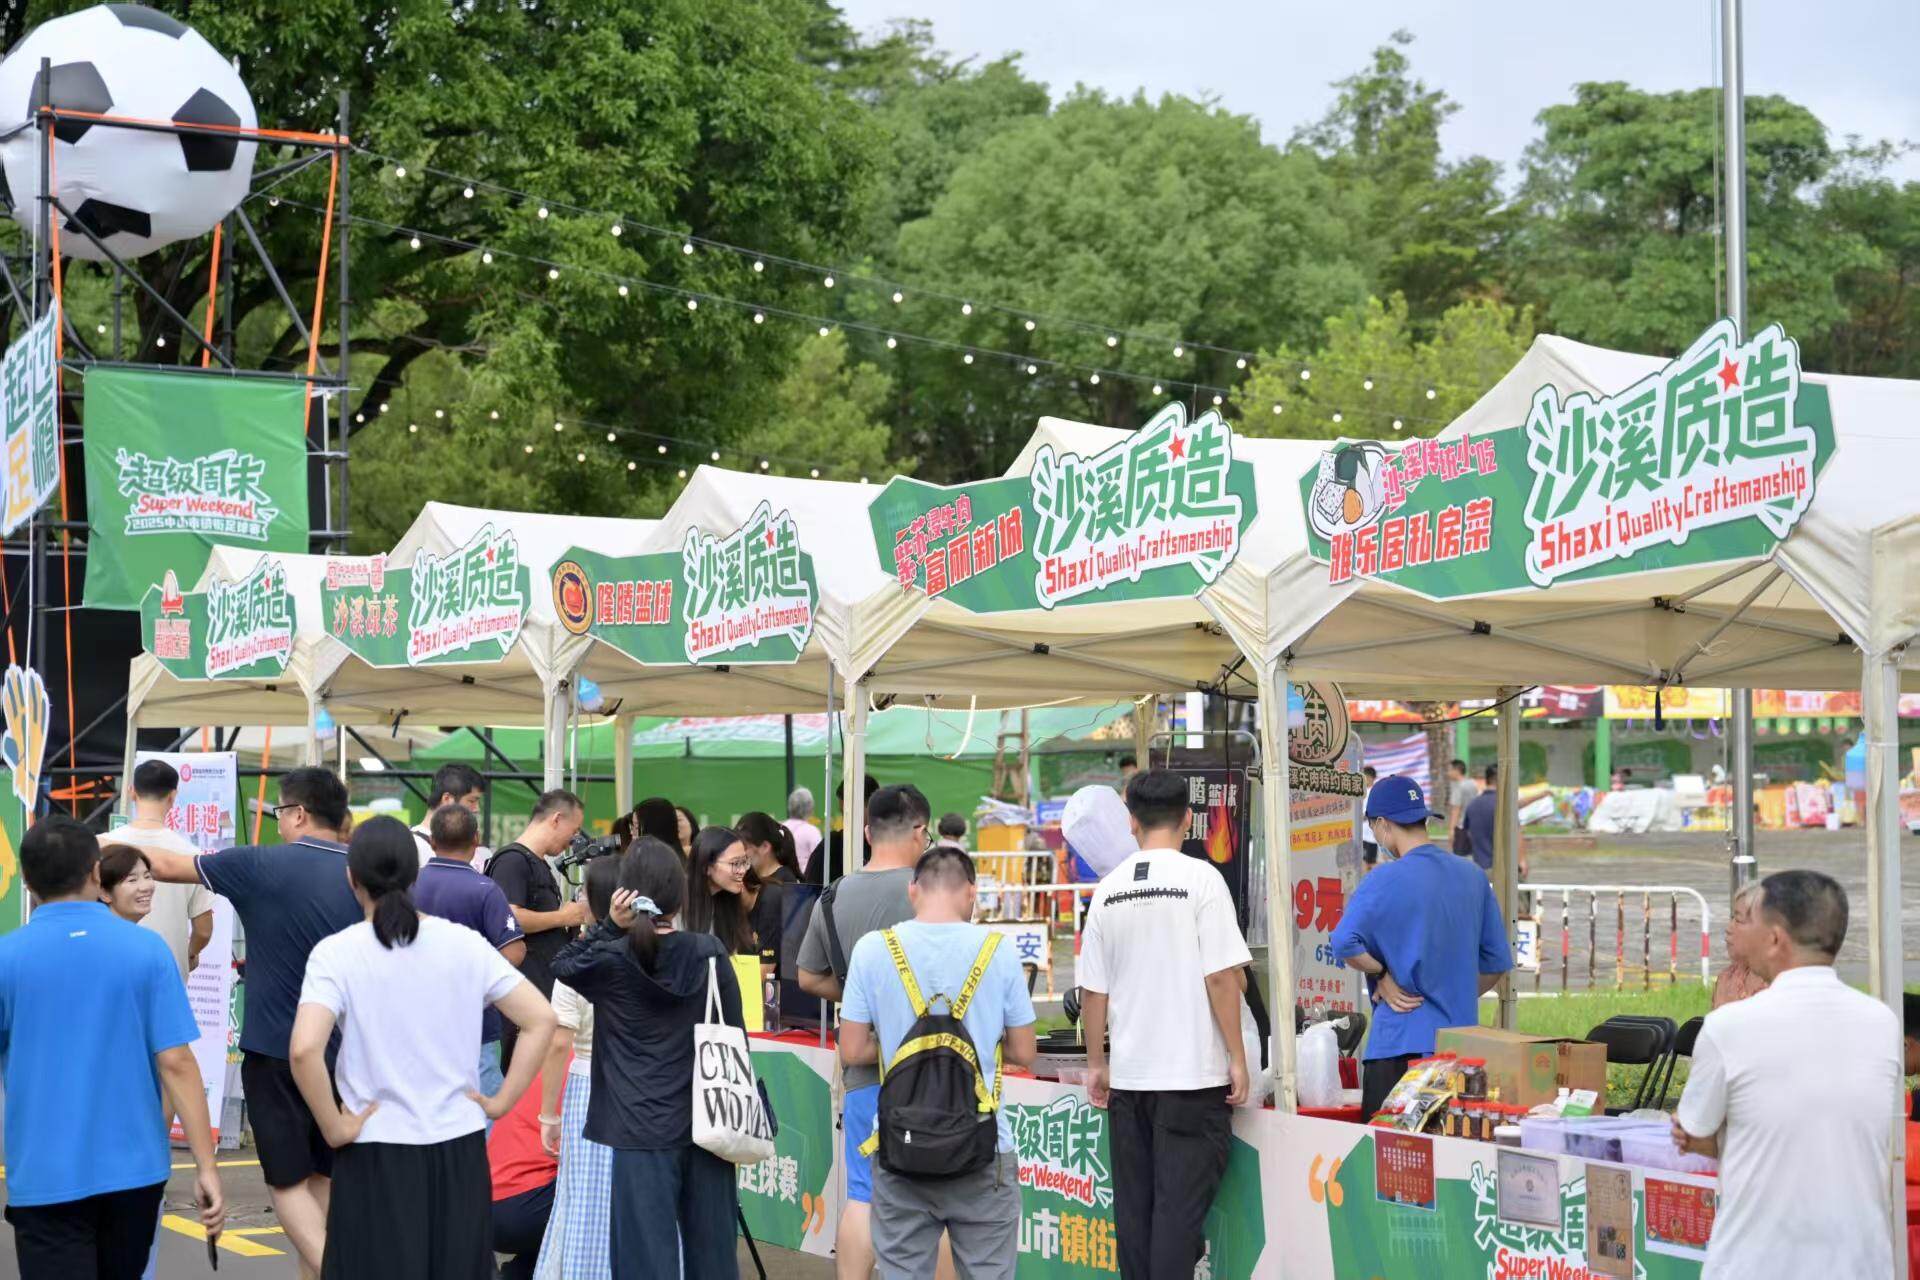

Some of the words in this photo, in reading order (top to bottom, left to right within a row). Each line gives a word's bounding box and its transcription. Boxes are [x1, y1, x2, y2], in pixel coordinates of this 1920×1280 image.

[1531, 334, 1808, 523] 沙溪质造
[117, 451, 270, 502] 超级周末
[1038, 417, 1236, 555] 沙溪质造
[138, 494, 182, 515] Super
[186, 496, 255, 519] Weekend
[926, 506, 1024, 598] 富丽新城
[1541, 505, 1610, 569] Shaxi
[409, 533, 520, 627] 沙溪质造
[685, 515, 808, 623] 沙溪质造
[1045, 546, 1093, 594] Shaxi
[208, 564, 290, 648] 沙溪质造
[596, 580, 673, 625] 隆腾篮球
[412, 623, 441, 657] Shaxi
[690, 616, 726, 651] Shaxi
[1184, 776, 1237, 806] 腾篮球
[1291, 876, 1344, 933] 9元
[1016, 932, 1041, 959] 安
[1006, 1101, 1106, 1178] 级周末
[1034, 1163, 1094, 1204] Weekend
